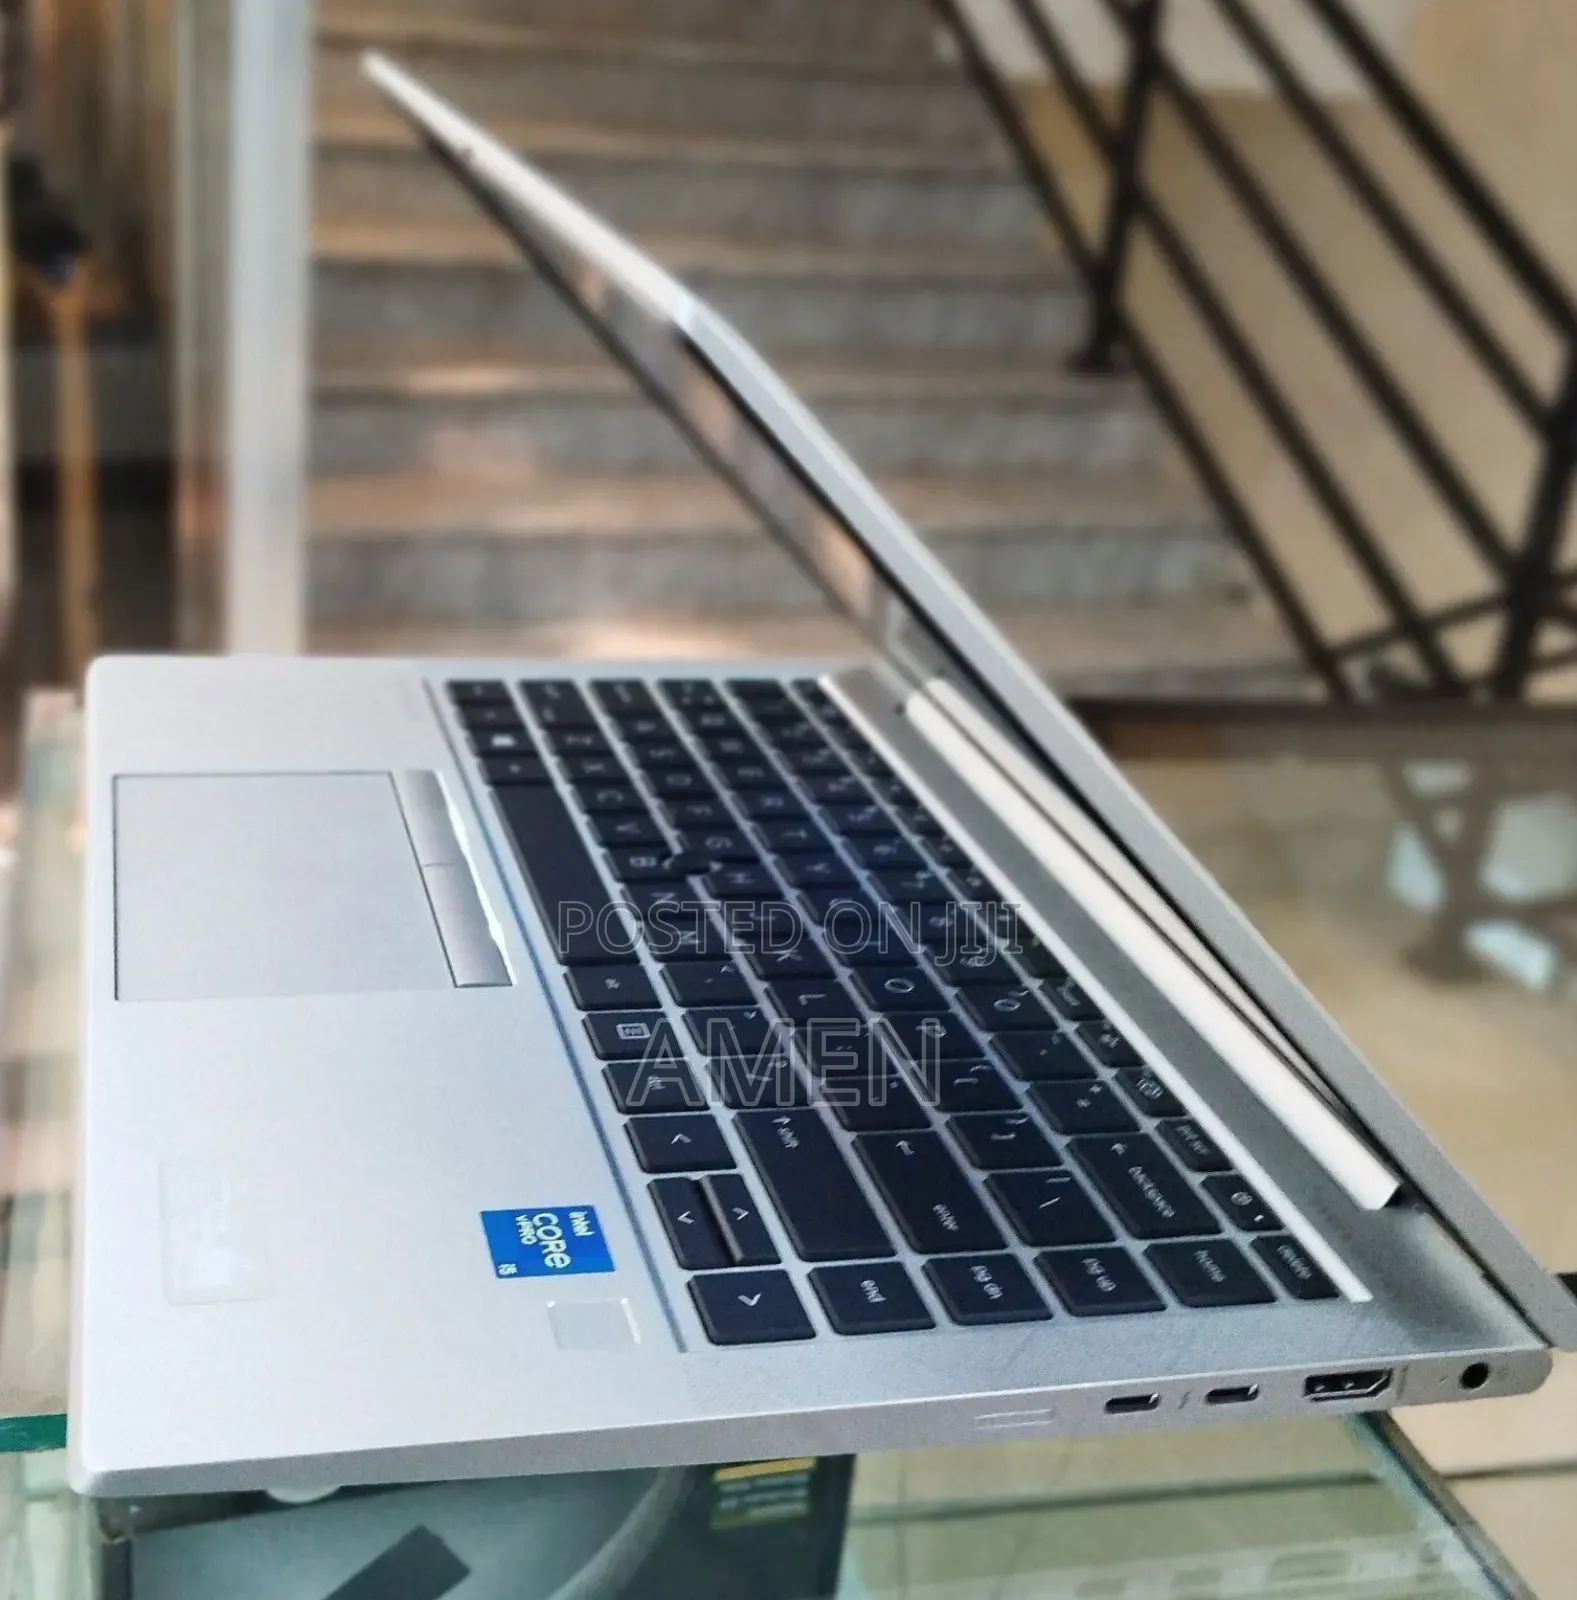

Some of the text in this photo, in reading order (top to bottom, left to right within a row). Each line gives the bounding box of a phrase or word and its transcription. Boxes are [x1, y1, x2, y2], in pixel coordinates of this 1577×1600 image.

[884, 978, 915, 993] O
[1127, 1165, 1176, 1218] backspace
[515, 1214, 538, 1245] vPRO
[569, 1210, 595, 1236] intel
[933, 1204, 959, 1231] enter
[1193, 1249, 1227, 1283] home
[860, 1279, 888, 1304] end
